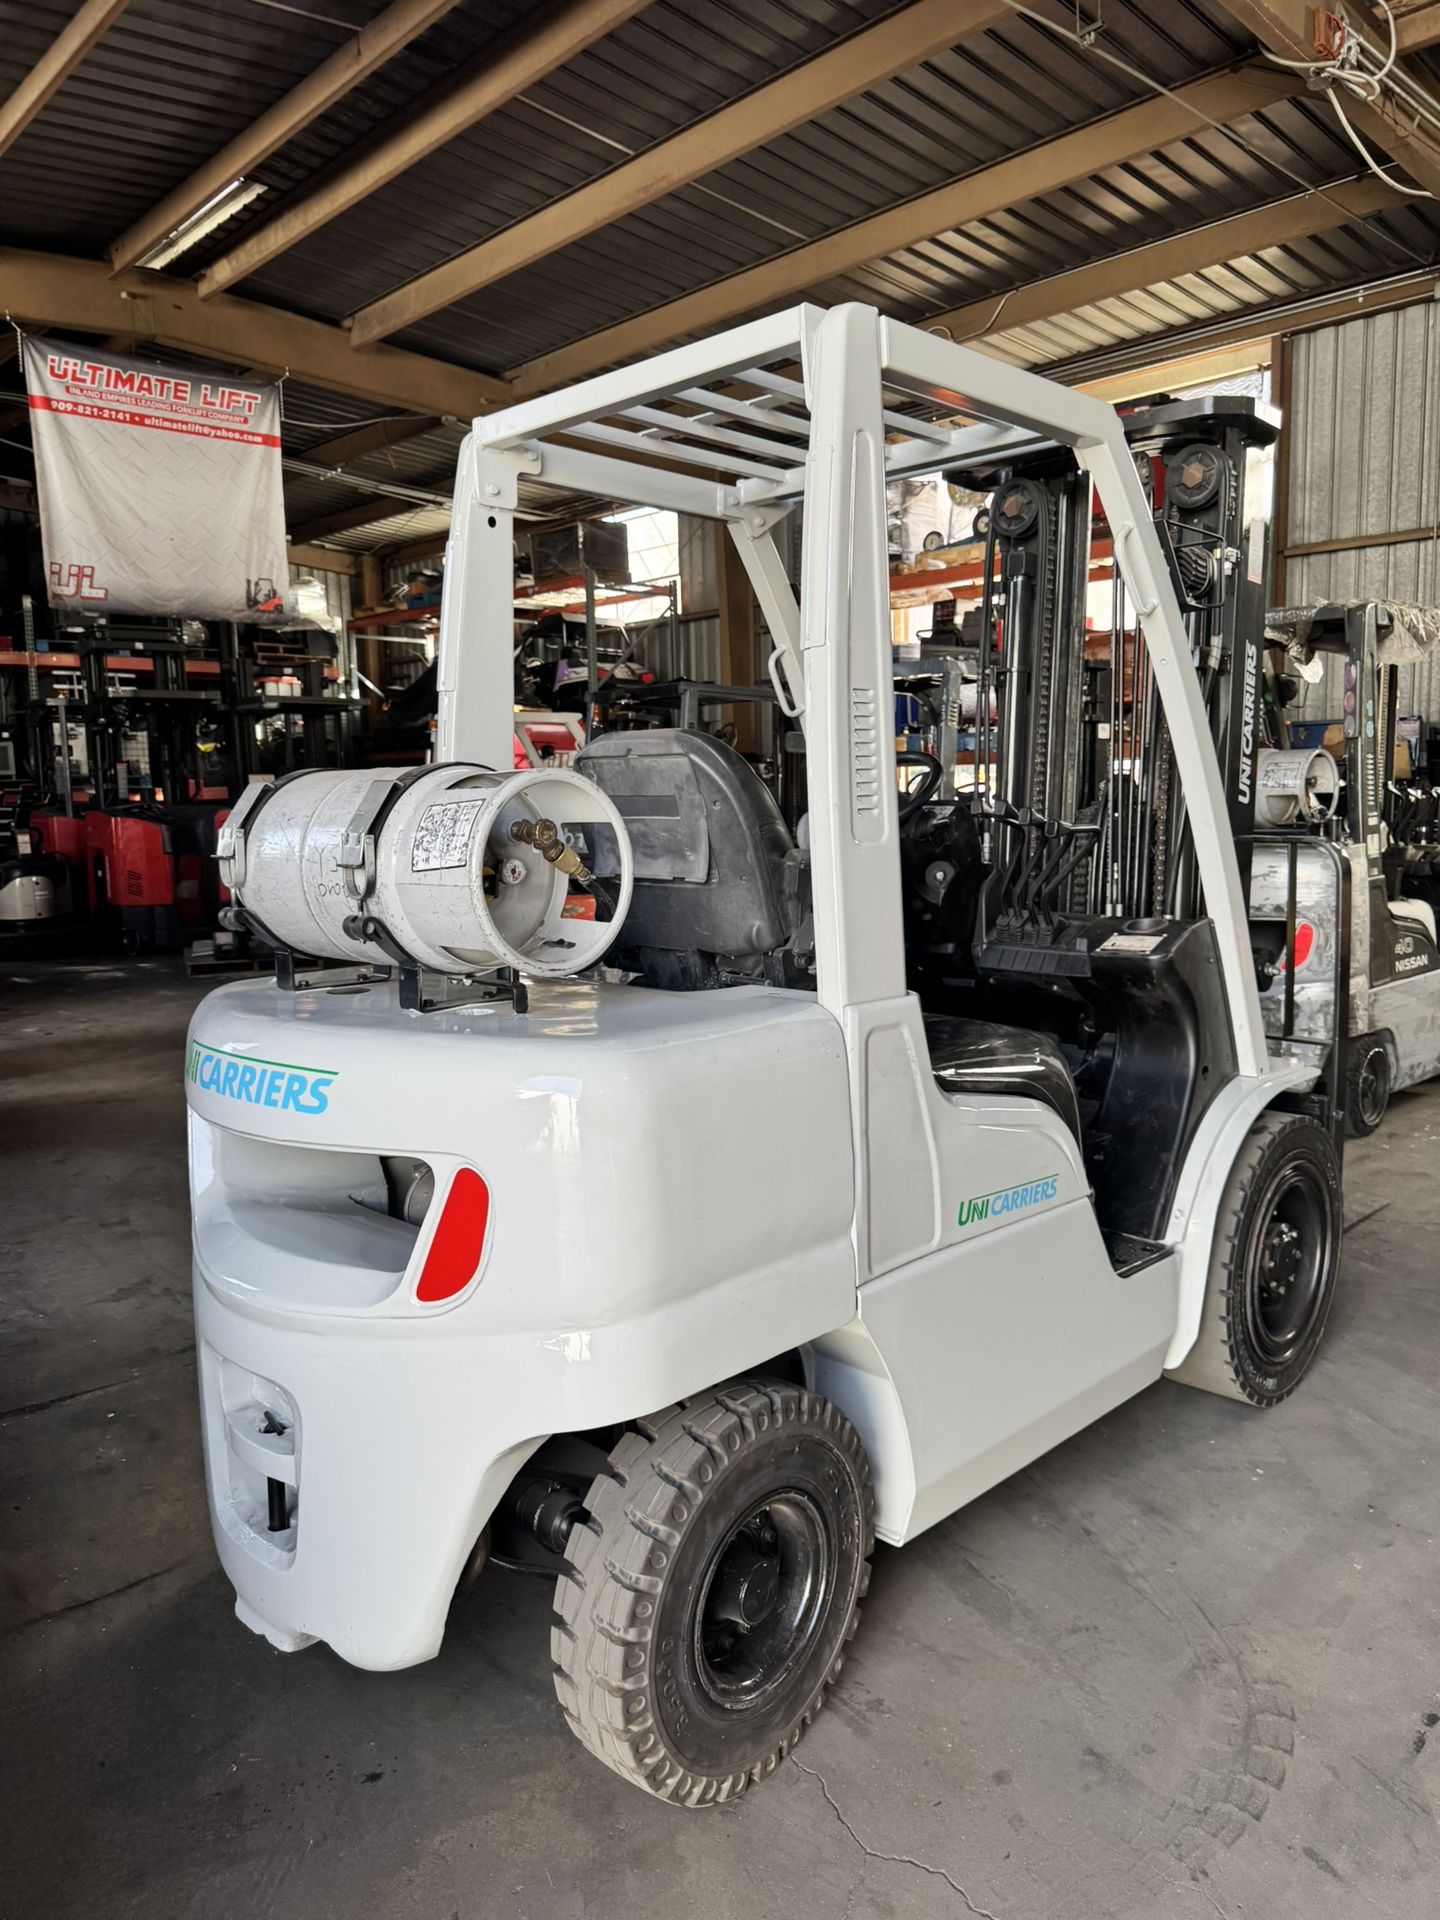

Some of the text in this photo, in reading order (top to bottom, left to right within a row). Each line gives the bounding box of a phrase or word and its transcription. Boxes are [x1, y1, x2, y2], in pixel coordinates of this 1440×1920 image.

[47, 354, 261, 416] ULTIMATE LIFT
[69, 386, 245, 424] INLAND EMPIRES LEADING FORKLIFT COMPANY
[50, 400, 263, 443] 909-821-2141 ultimatelift@yahoo.com
[49, 562, 108, 601] UL
[1238, 640, 1257, 804] UNICARRIERS
[1394, 937, 1414, 955] 40
[1394, 954, 1428, 973] NISSAN
[957, 1178, 1058, 1227] UNICARRIERS
